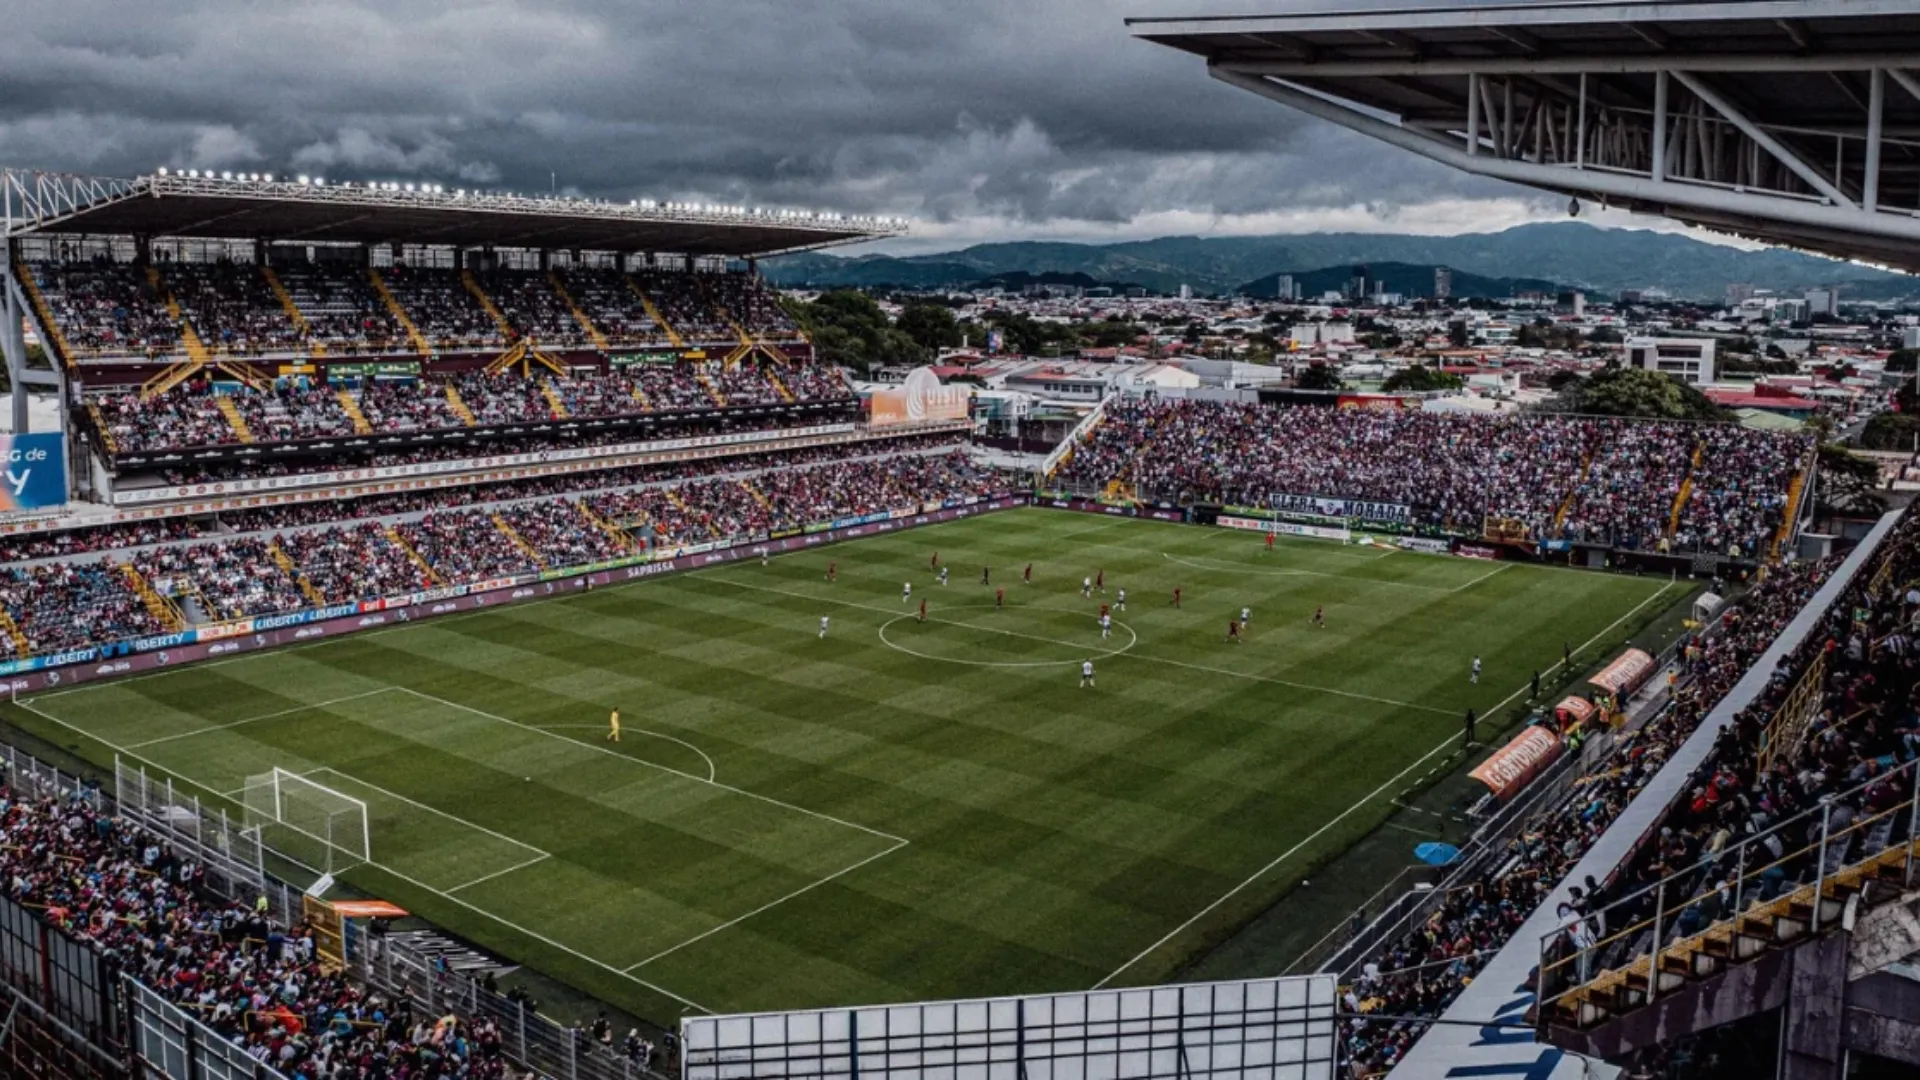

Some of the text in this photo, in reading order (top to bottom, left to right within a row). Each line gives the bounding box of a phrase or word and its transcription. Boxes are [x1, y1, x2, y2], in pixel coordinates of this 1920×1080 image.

[25, 447, 47, 461] de
[0, 468, 31, 496] y
[1271, 494, 1317, 514] ULTRA
[1342, 500, 1406, 521] MORADA
[627, 560, 675, 578] SAPRISSA
[308, 603, 357, 620] LIBERTY
[256, 613, 306, 630] LIBERTY
[132, 633, 184, 651] IBERTY
[44, 648, 97, 666] LIBERT
